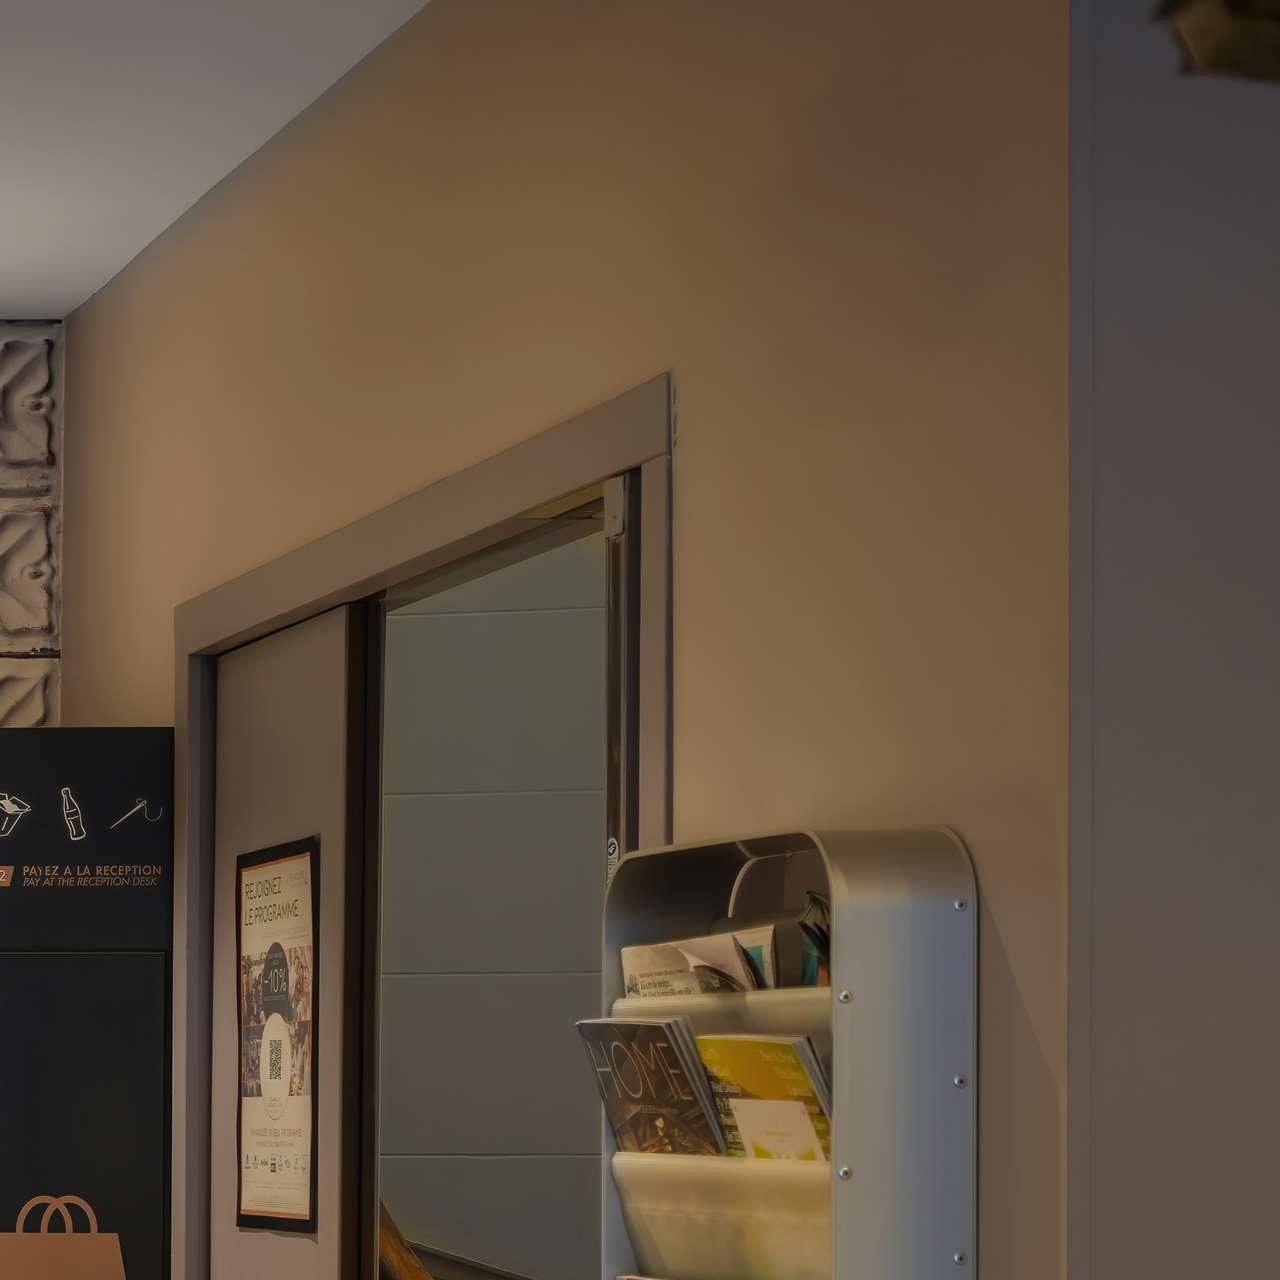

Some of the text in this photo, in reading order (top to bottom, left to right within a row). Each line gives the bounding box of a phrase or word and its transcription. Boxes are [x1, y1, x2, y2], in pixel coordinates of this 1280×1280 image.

[23, 866, 58, 876] PAYEZ
[77, 866, 91, 876] LA
[96, 866, 162, 876] RECEPTION
[23, 876, 158, 886] PAY AT THE RECEPTION DESK
[245, 899, 299, 926] LE PROGRAMME
[264, 968, 286, 993] -10%
[585, 1040, 693, 1100] HOME
